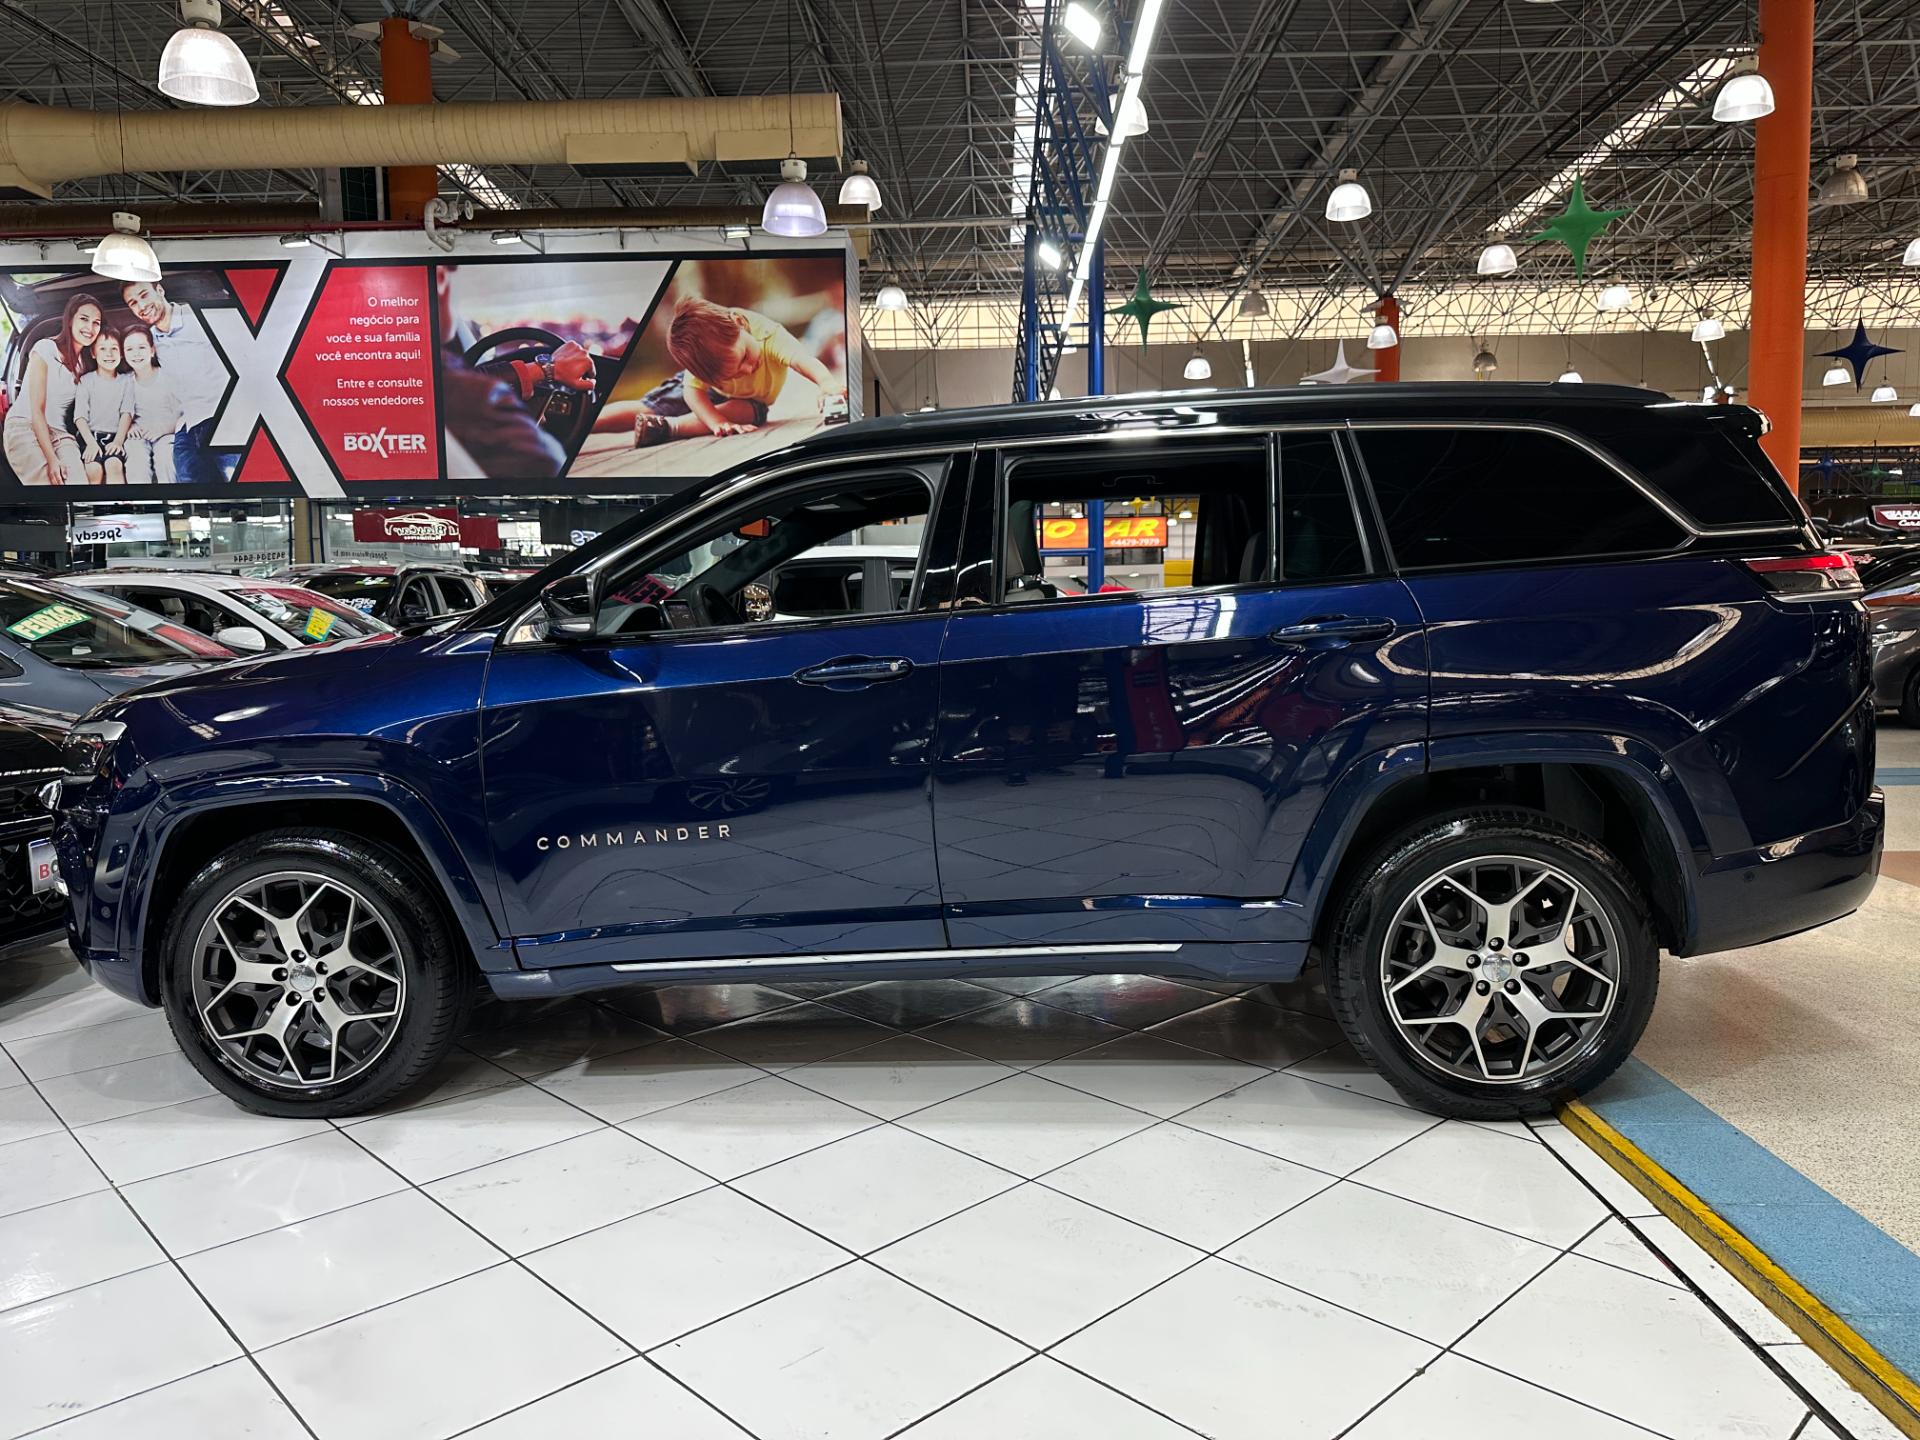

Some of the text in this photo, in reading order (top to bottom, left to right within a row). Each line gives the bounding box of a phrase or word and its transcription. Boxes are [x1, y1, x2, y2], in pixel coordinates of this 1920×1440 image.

[367, 296, 419, 307] O melhor
[349, 315, 420, 328] negócio para
[326, 331, 421, 343] você e sua família
[315, 349, 421, 362] você encontra aqui!
[336, 377, 423, 389] Entre e consulte
[322, 395, 425, 407] nossos vendedores
[343, 427, 427, 458] BOXTER
[536, 824, 732, 851] COMMANDER
